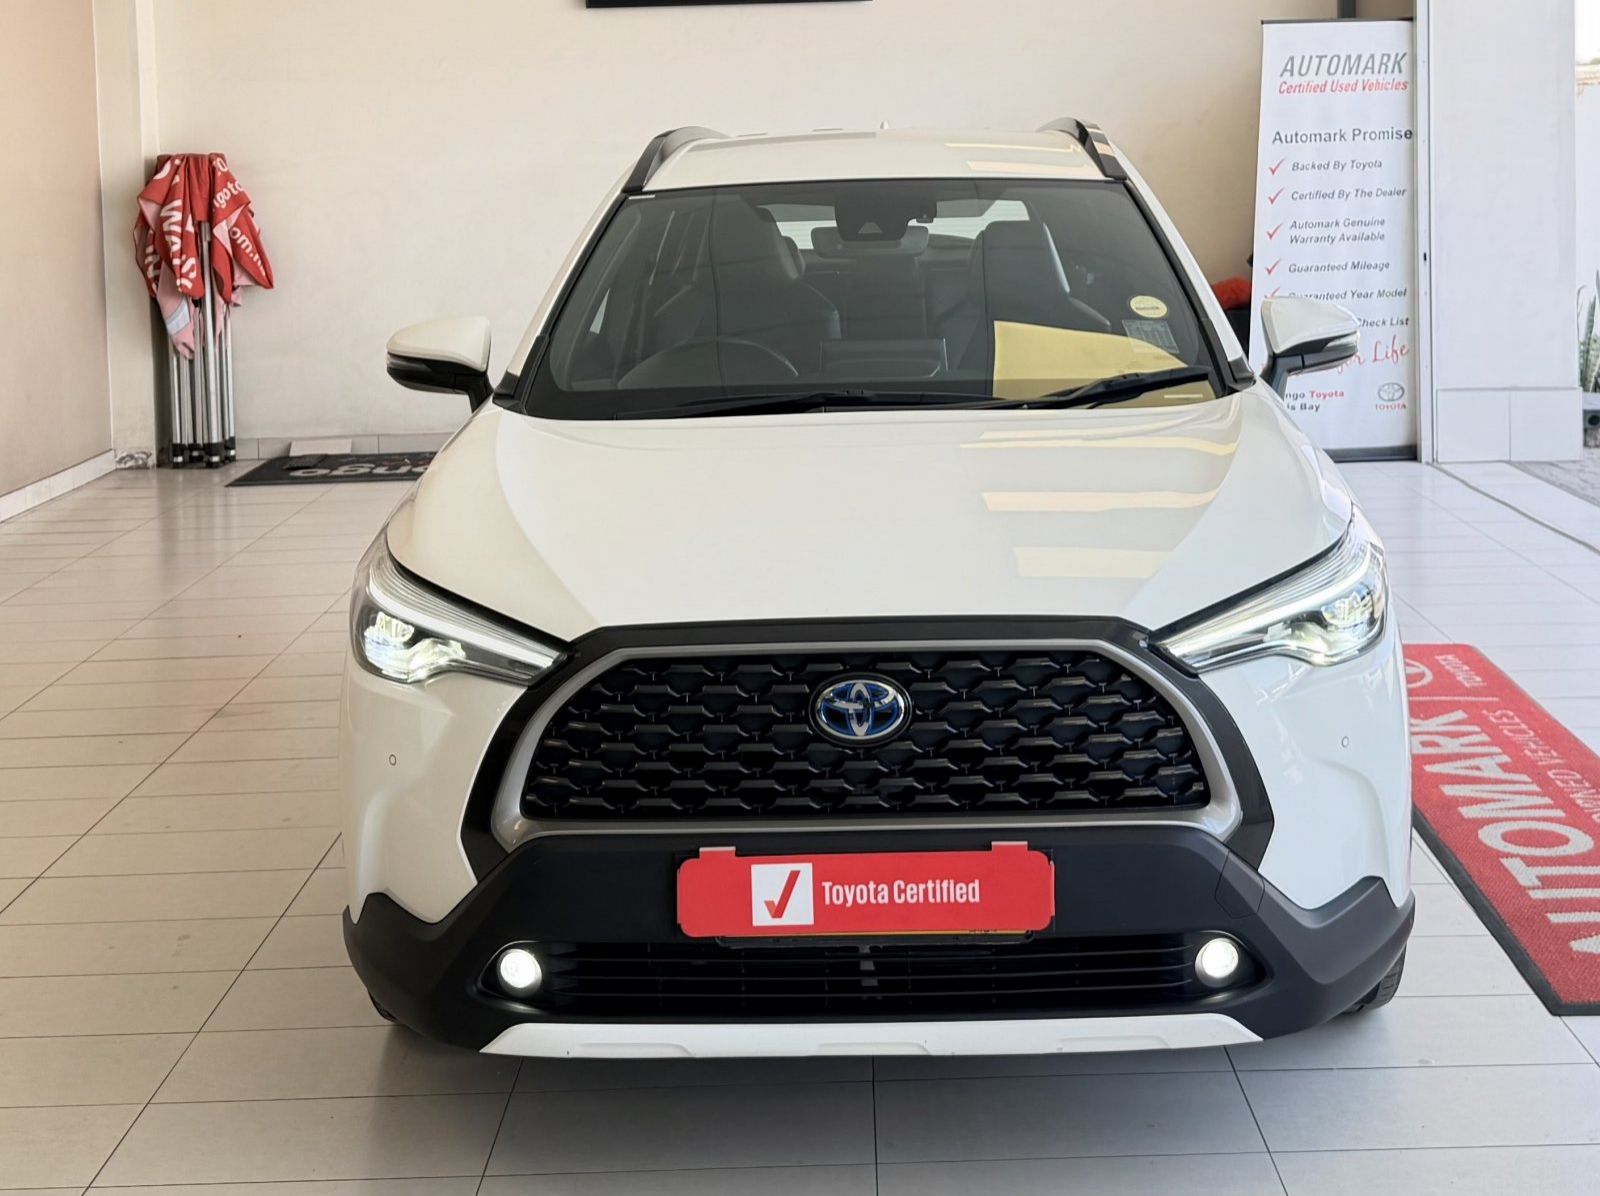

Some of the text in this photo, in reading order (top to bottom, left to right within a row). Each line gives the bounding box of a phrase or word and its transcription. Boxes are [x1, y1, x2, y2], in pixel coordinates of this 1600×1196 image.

[1280, 52, 1408, 77] AUTOMARK
[1278, 78, 1409, 95] Certified Used Vehicles
[1272, 126, 1413, 145] Automark Promise
[1291, 160, 1382, 172] Backed By Toyota
[1291, 187, 1407, 201] Certified By The Dealer
[1290, 218, 1385, 230] Automark Genuine
[1289, 232, 1385, 245] Warranty Available
[1288, 261, 1390, 273] Guaranteed Mileage
[1351, 289, 1374, 299] Year
[1376, 288, 1407, 298] Model
[1390, 317, 1409, 327] List
[1373, 335, 1409, 364] Life
[1309, 390, 1345, 400] Toyota
[1300, 402, 1321, 412] Bay
[1375, 403, 1407, 411] TOYOTA
[1482, 708, 1566, 767] VEHICLES
[1410, 709, 1600, 954] UTOMARK
[822, 879, 980, 907] Toyota Certified
